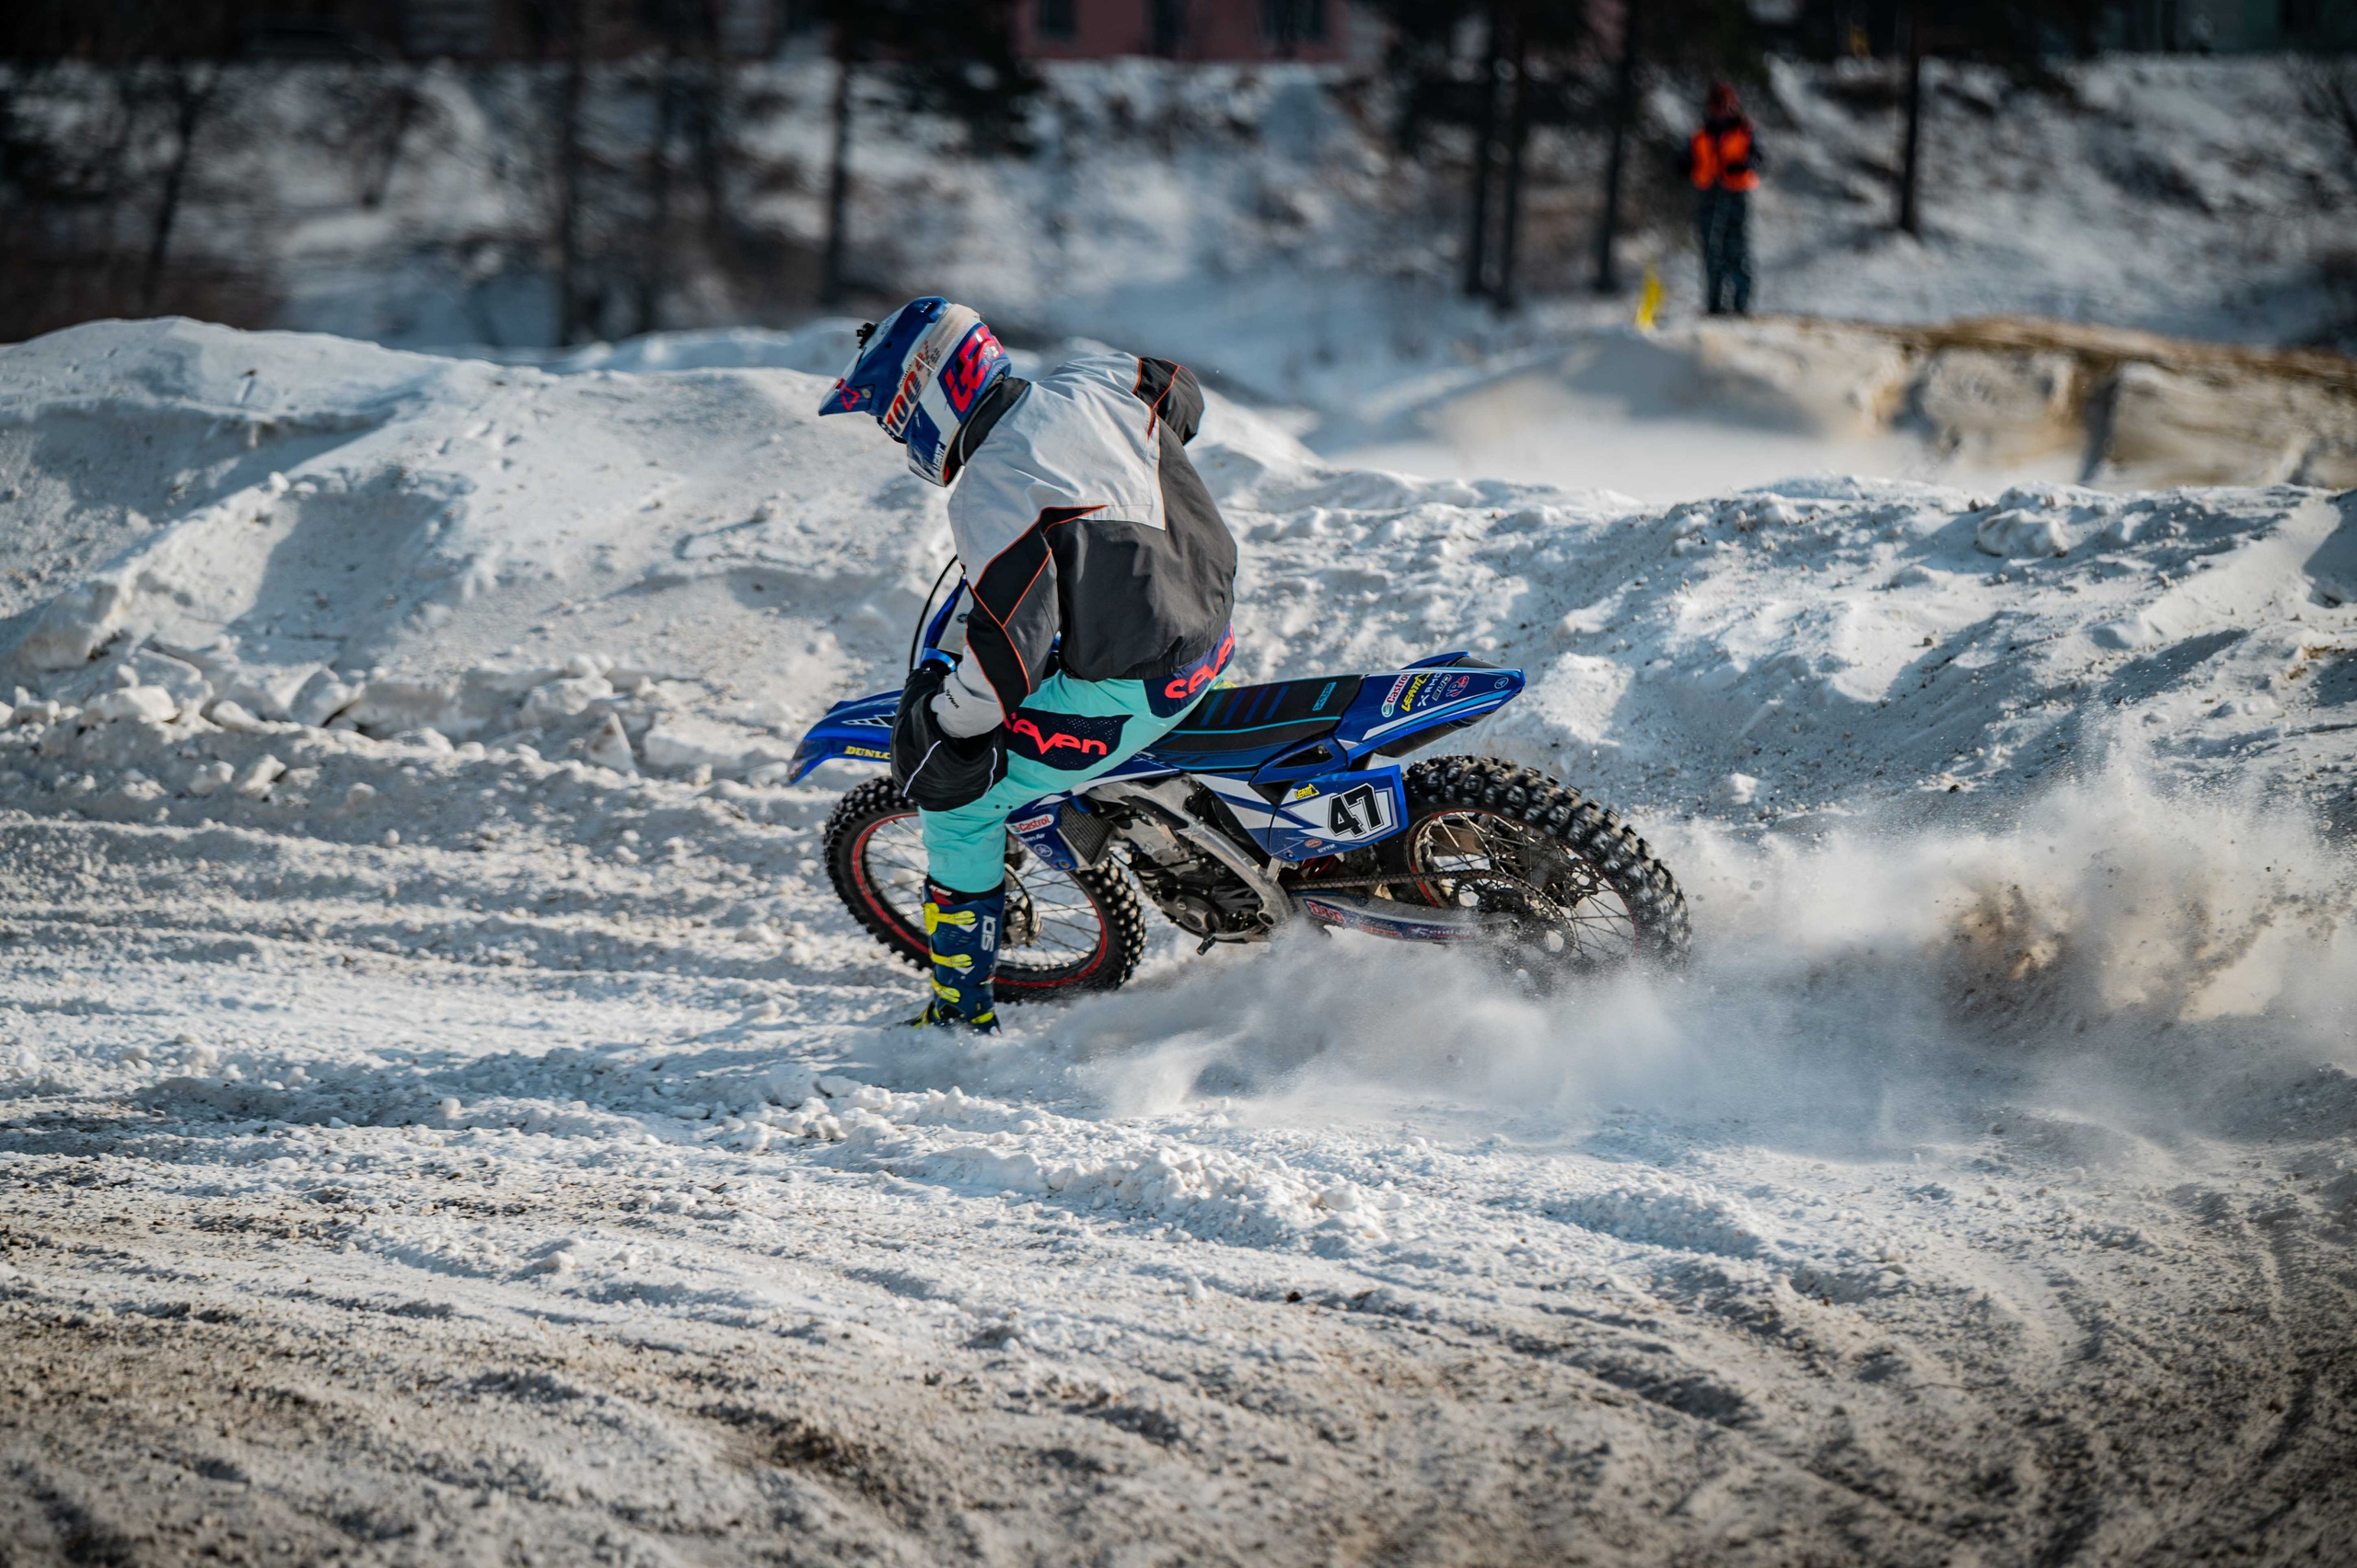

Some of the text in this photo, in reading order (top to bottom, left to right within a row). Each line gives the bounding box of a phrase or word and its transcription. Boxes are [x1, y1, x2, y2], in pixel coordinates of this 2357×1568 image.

[844, 746, 891, 760] DUNLO
[1328, 783, 1385, 838] 47
[1019, 815, 1051, 831] Castrol
